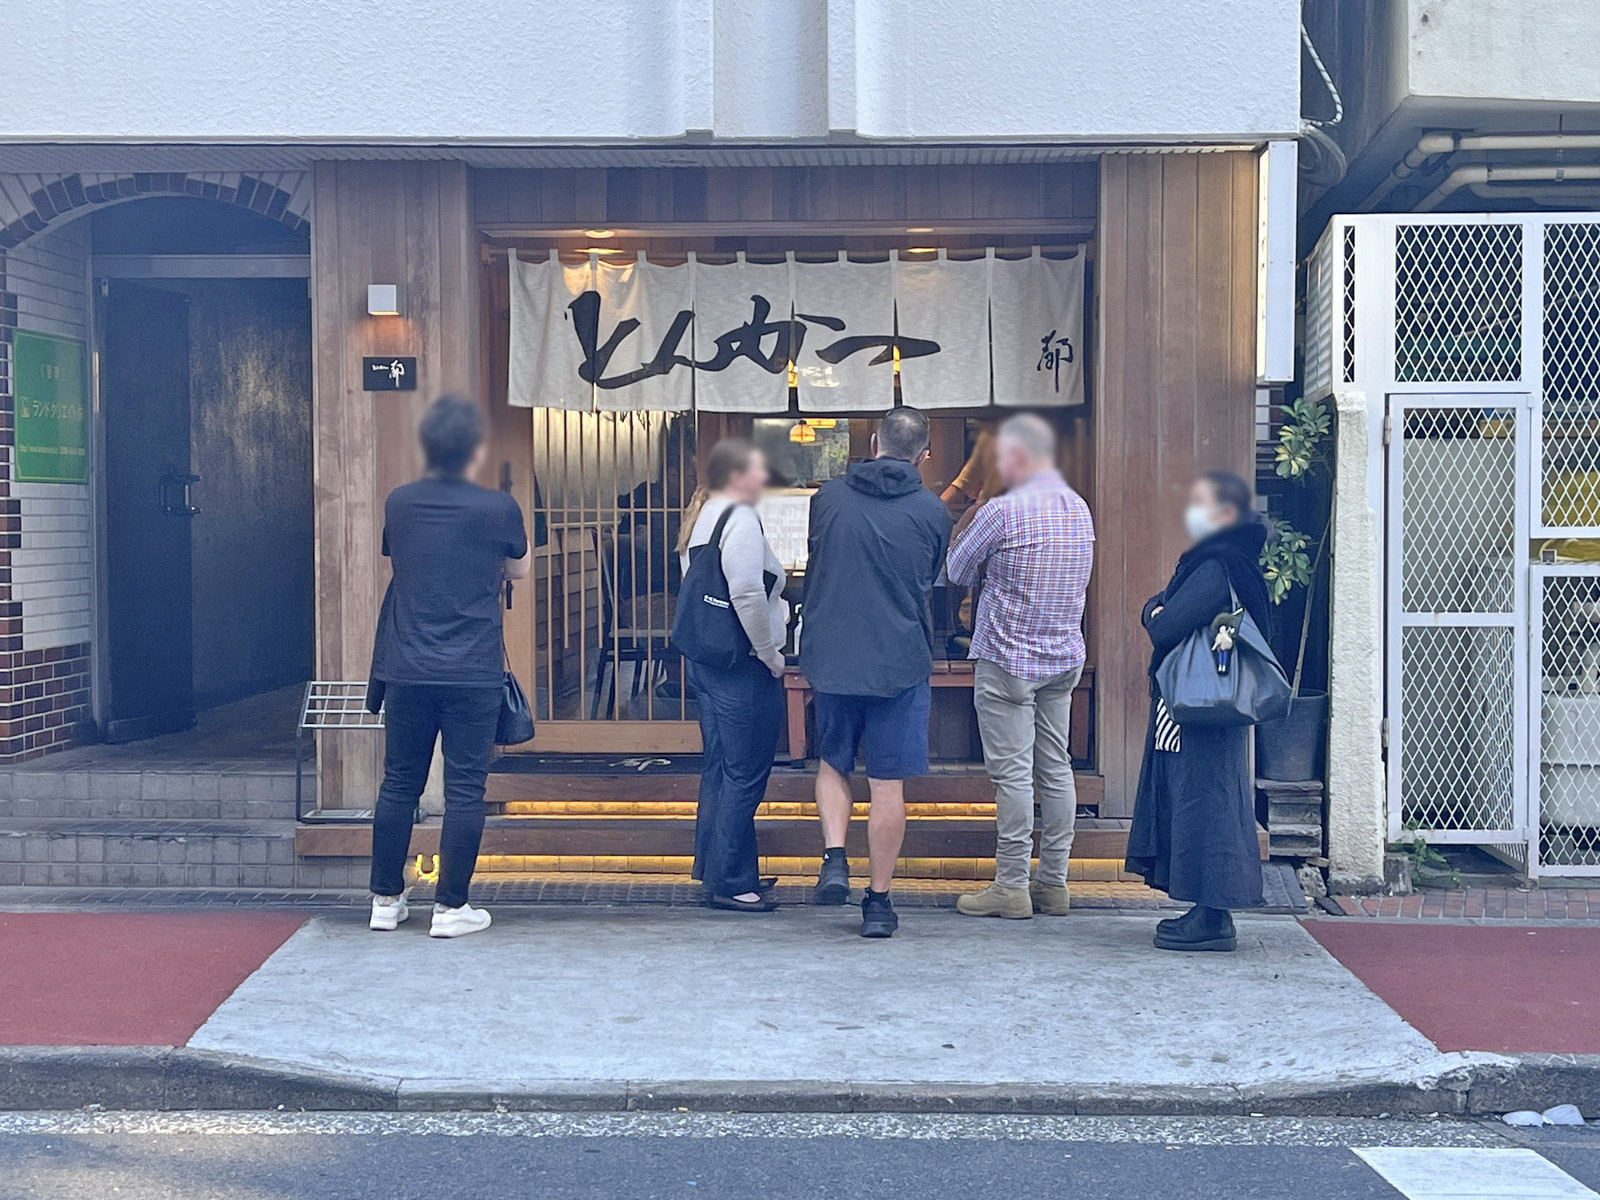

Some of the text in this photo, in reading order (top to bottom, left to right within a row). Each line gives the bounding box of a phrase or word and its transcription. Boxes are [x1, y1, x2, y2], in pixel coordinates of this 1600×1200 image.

[567, 290, 941, 389] とんかつ
[1037, 329, 1074, 393] 都
